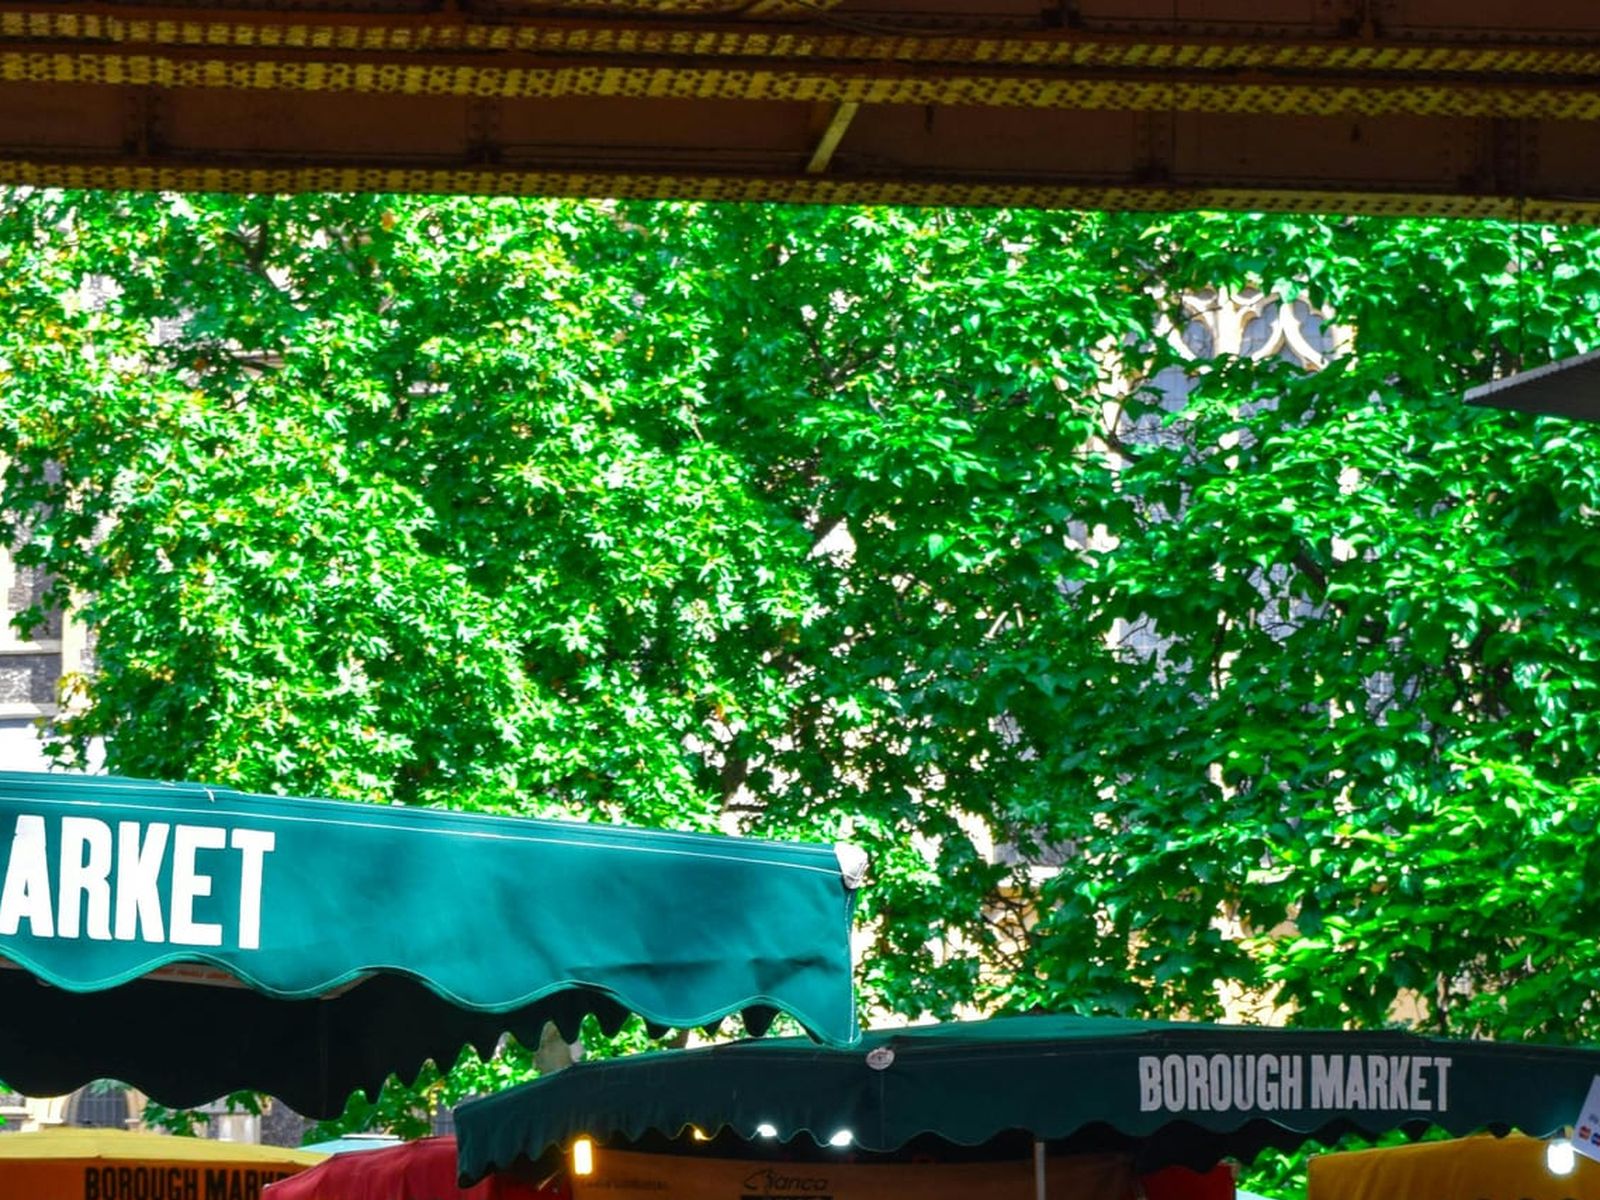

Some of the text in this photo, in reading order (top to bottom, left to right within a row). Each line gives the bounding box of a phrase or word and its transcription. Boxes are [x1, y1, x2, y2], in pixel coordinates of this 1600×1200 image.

[0, 815, 276, 950] ARKET
[1138, 1053, 1452, 1112] BOROUGH MARKET
